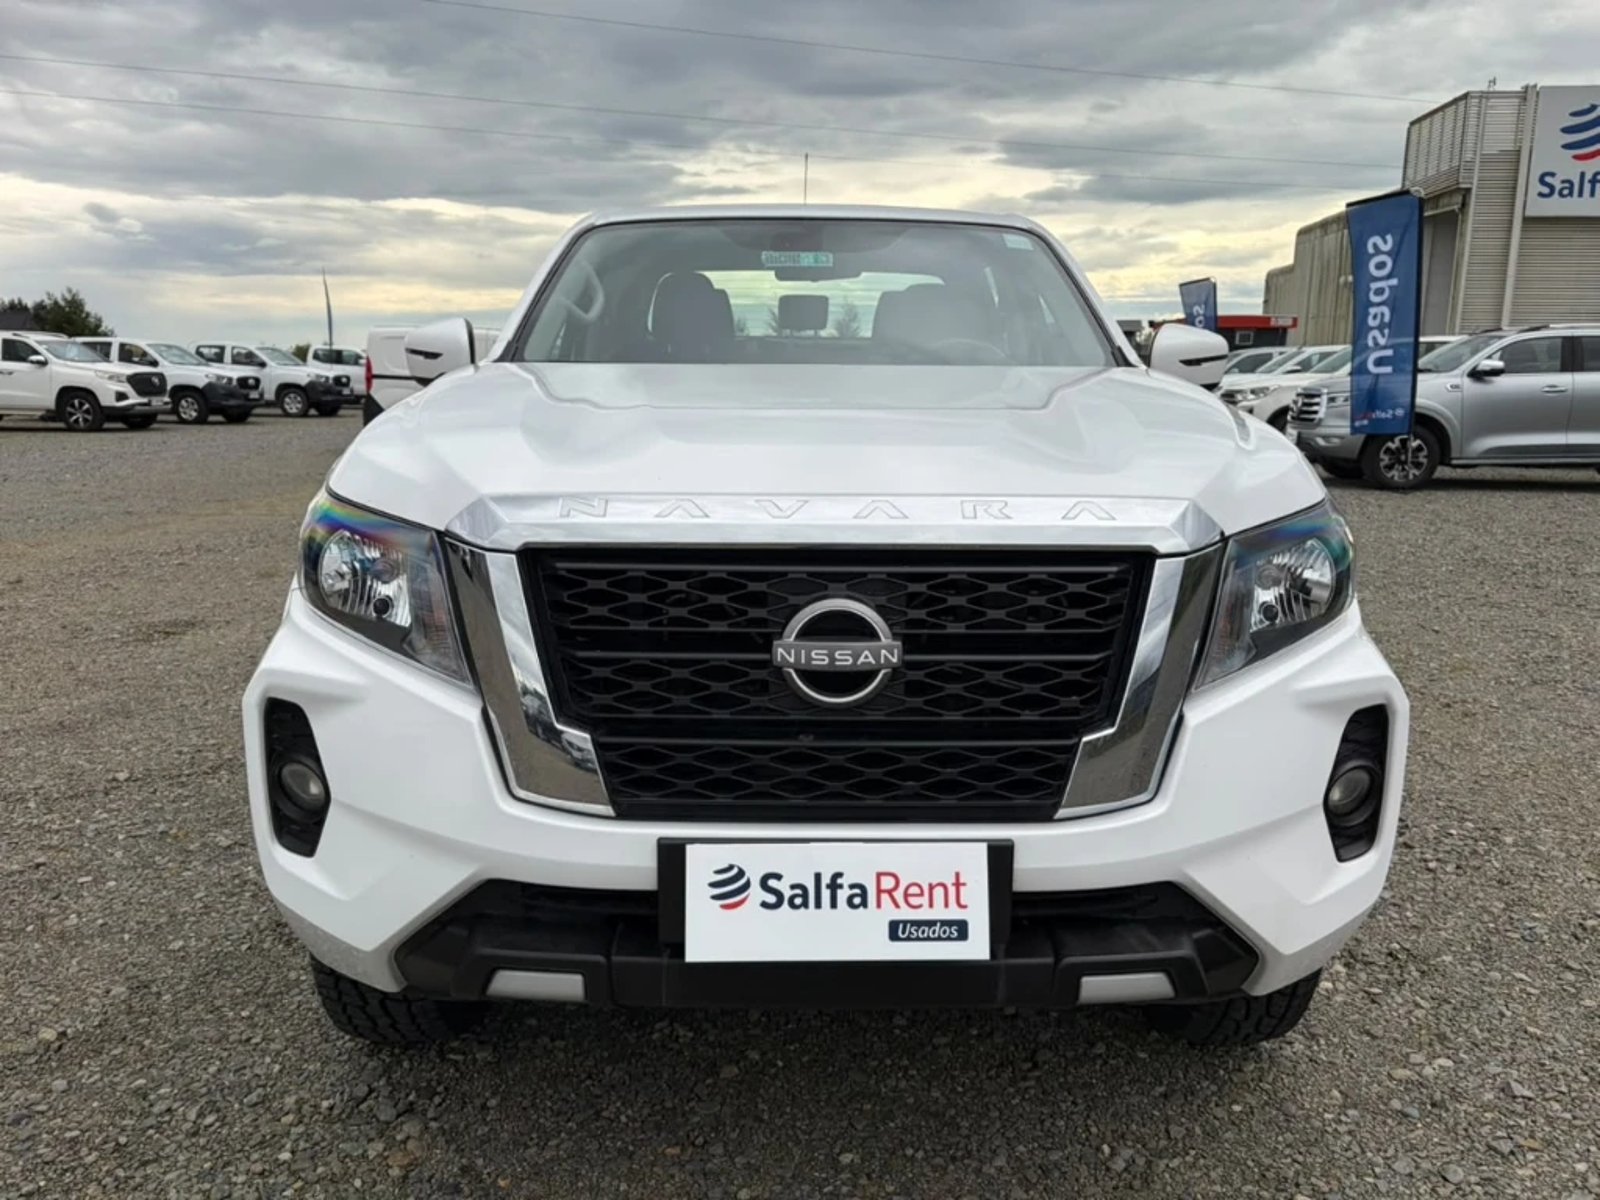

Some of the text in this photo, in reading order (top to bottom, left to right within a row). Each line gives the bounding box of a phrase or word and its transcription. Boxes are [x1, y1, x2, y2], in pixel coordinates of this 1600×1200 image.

[558, 497, 1117, 521] NAVARA
[777, 647, 898, 665] NISSAN
[759, 871, 968, 911] SalfaRent
[897, 922, 959, 940] Usados
